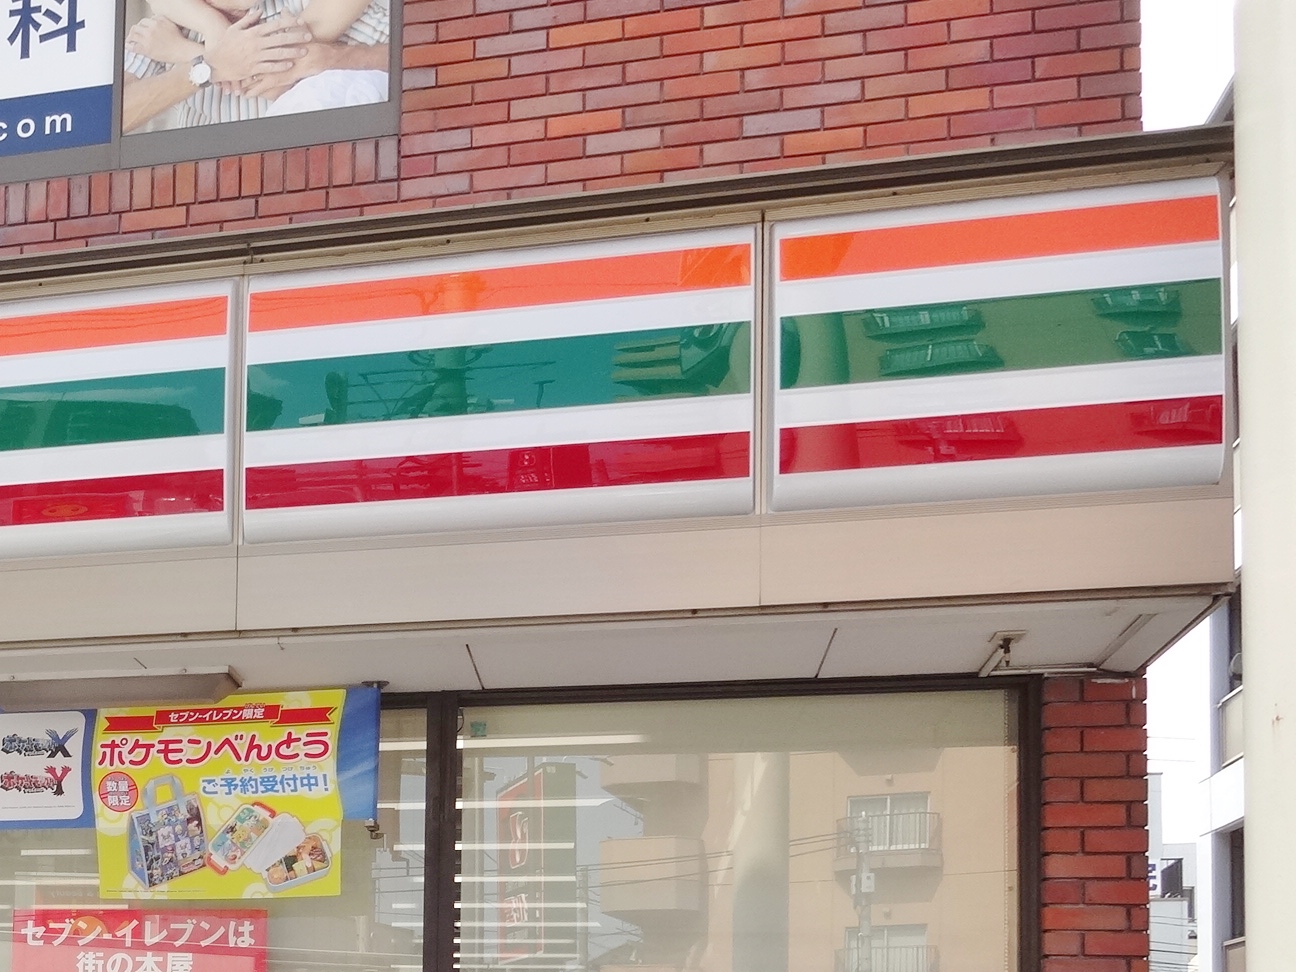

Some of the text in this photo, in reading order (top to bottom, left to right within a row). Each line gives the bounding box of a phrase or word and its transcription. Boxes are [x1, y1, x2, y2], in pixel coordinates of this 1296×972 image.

[98, 731, 330, 767] ポケモンべんとう
[106, 780, 129, 792] 数量
[201, 773, 330, 796] ご予約受付中!
[107, 794, 131, 806] 限定
